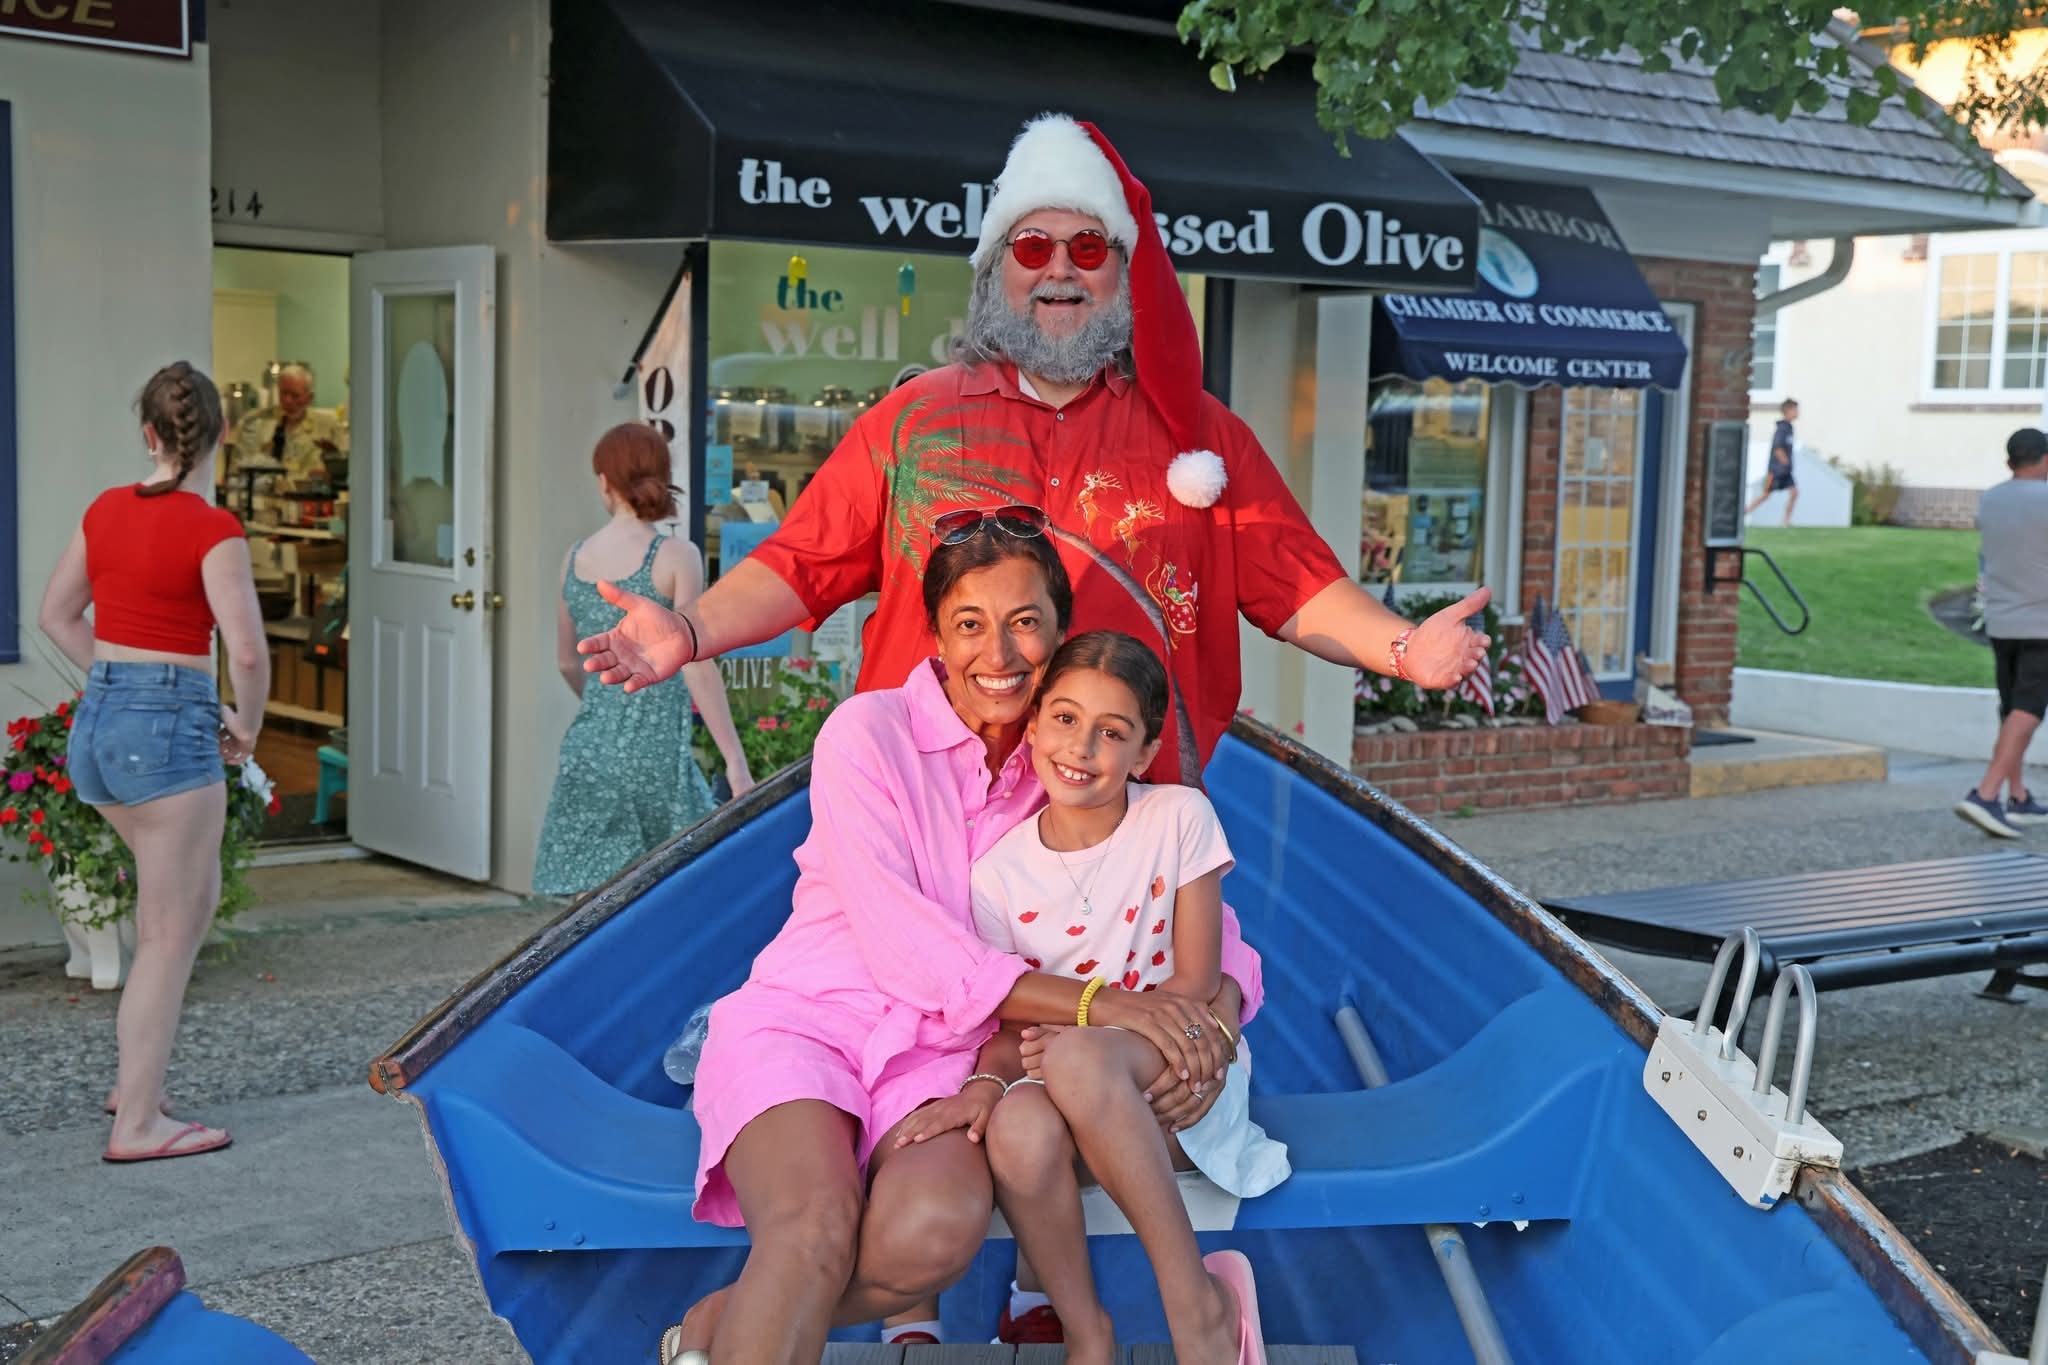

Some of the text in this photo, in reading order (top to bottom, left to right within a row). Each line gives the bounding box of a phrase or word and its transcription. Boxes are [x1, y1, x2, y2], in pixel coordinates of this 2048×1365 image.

[738, 158, 1464, 271] the wel ssed Olive
[777, 276, 844, 313] the
[1384, 293, 1672, 332] CHAMBER OF COMMERCE
[761, 305, 899, 362] well
[1445, 352, 1652, 379] WELCOME CENTER
[719, 657, 773, 689] OLIVE
